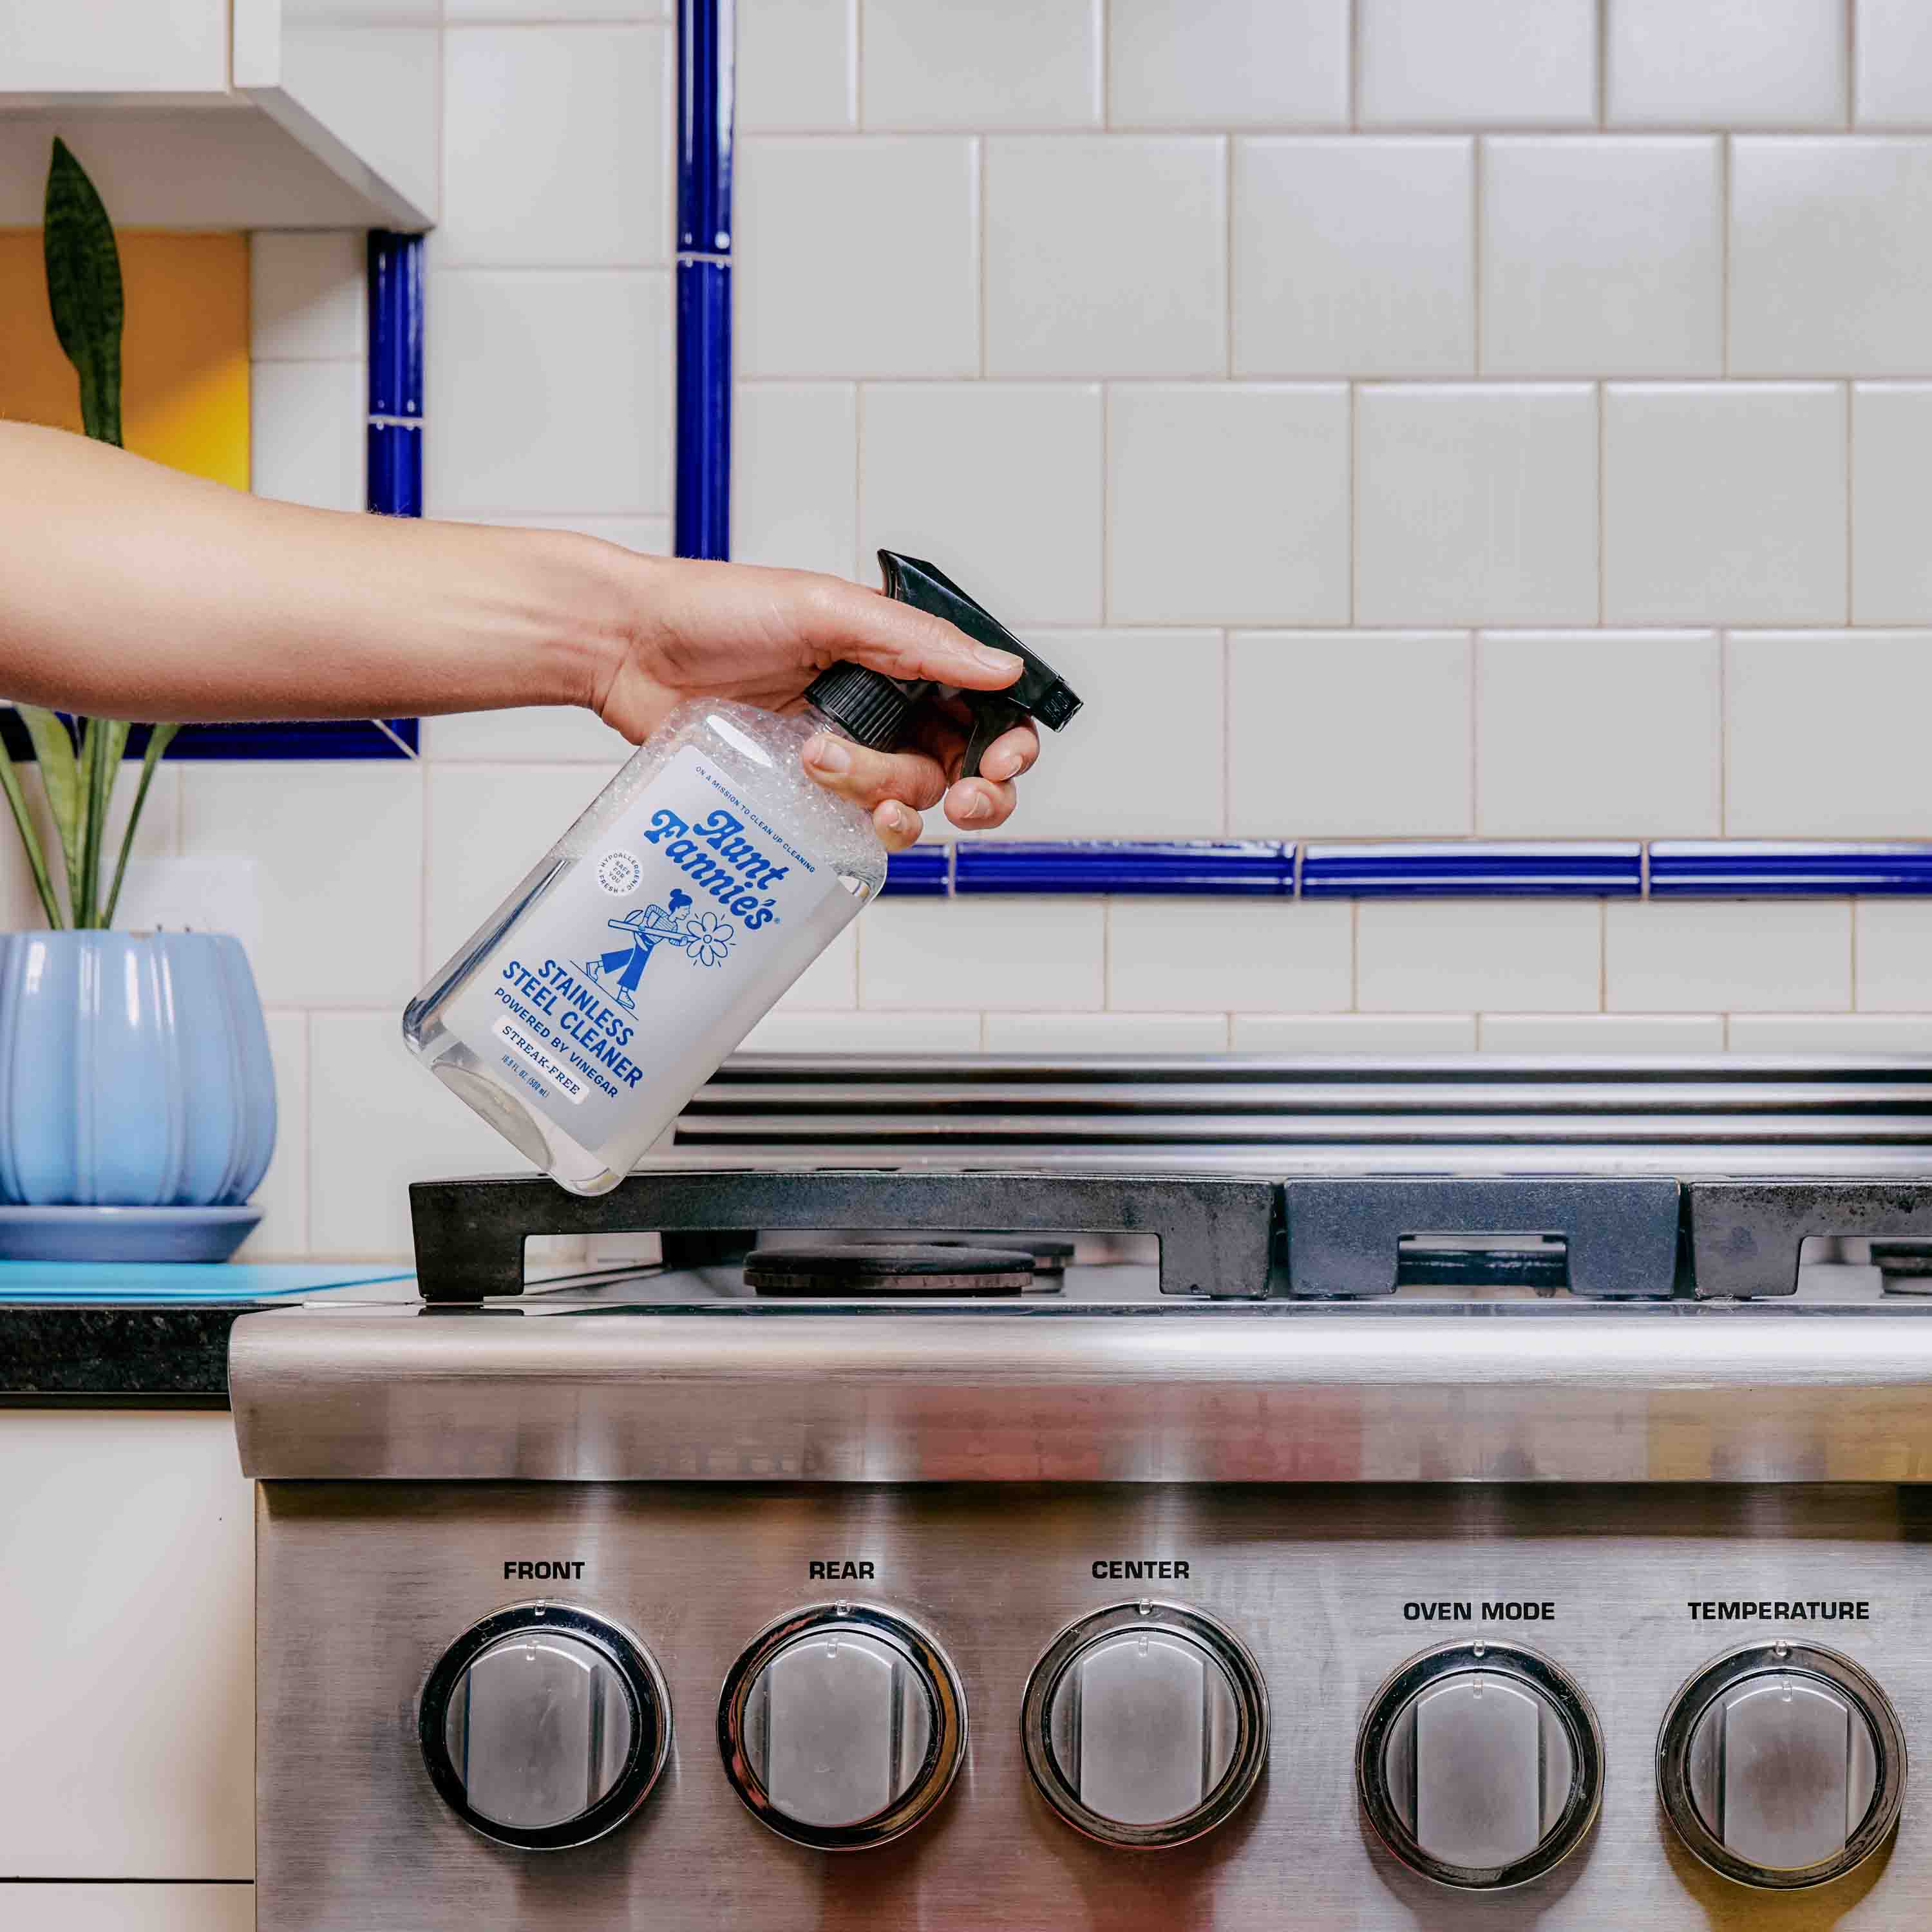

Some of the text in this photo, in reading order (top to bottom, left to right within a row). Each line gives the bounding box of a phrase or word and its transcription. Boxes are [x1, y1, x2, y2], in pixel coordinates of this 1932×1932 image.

[696, 766, 705, 775] ON
[711, 780, 739, 806] MISSION
[741, 805, 750, 815] TO
[750, 815, 773, 835] CLEAN
[773, 834, 783, 843] UP
[782, 844, 815, 873] CLEANING
[693, 810, 789, 889] Aunt
[600, 853, 639, 891] HYPOALLERGENIC
[613, 867, 625, 878] FOR
[615, 860, 630, 875] SAFE
[600, 875, 618, 893] FRESH
[609, 871, 621, 883] YOU
[538, 960, 634, 1046] STAINLESS
[503, 961, 643, 1088] STEEL CLEANER
[495, 987, 618, 1097] POWERED BY VINEGAR
[502, 1025, 580, 1095] STREAK-FREE
[505, 1562, 585, 1579] FRONT
[810, 1562, 874, 1579] REAR
[1092, 1561, 1189, 1578] CENTER
[1405, 1602, 1554, 1620] OVEN MODE
[1688, 1602, 1869, 1619] TEMPERATURE
